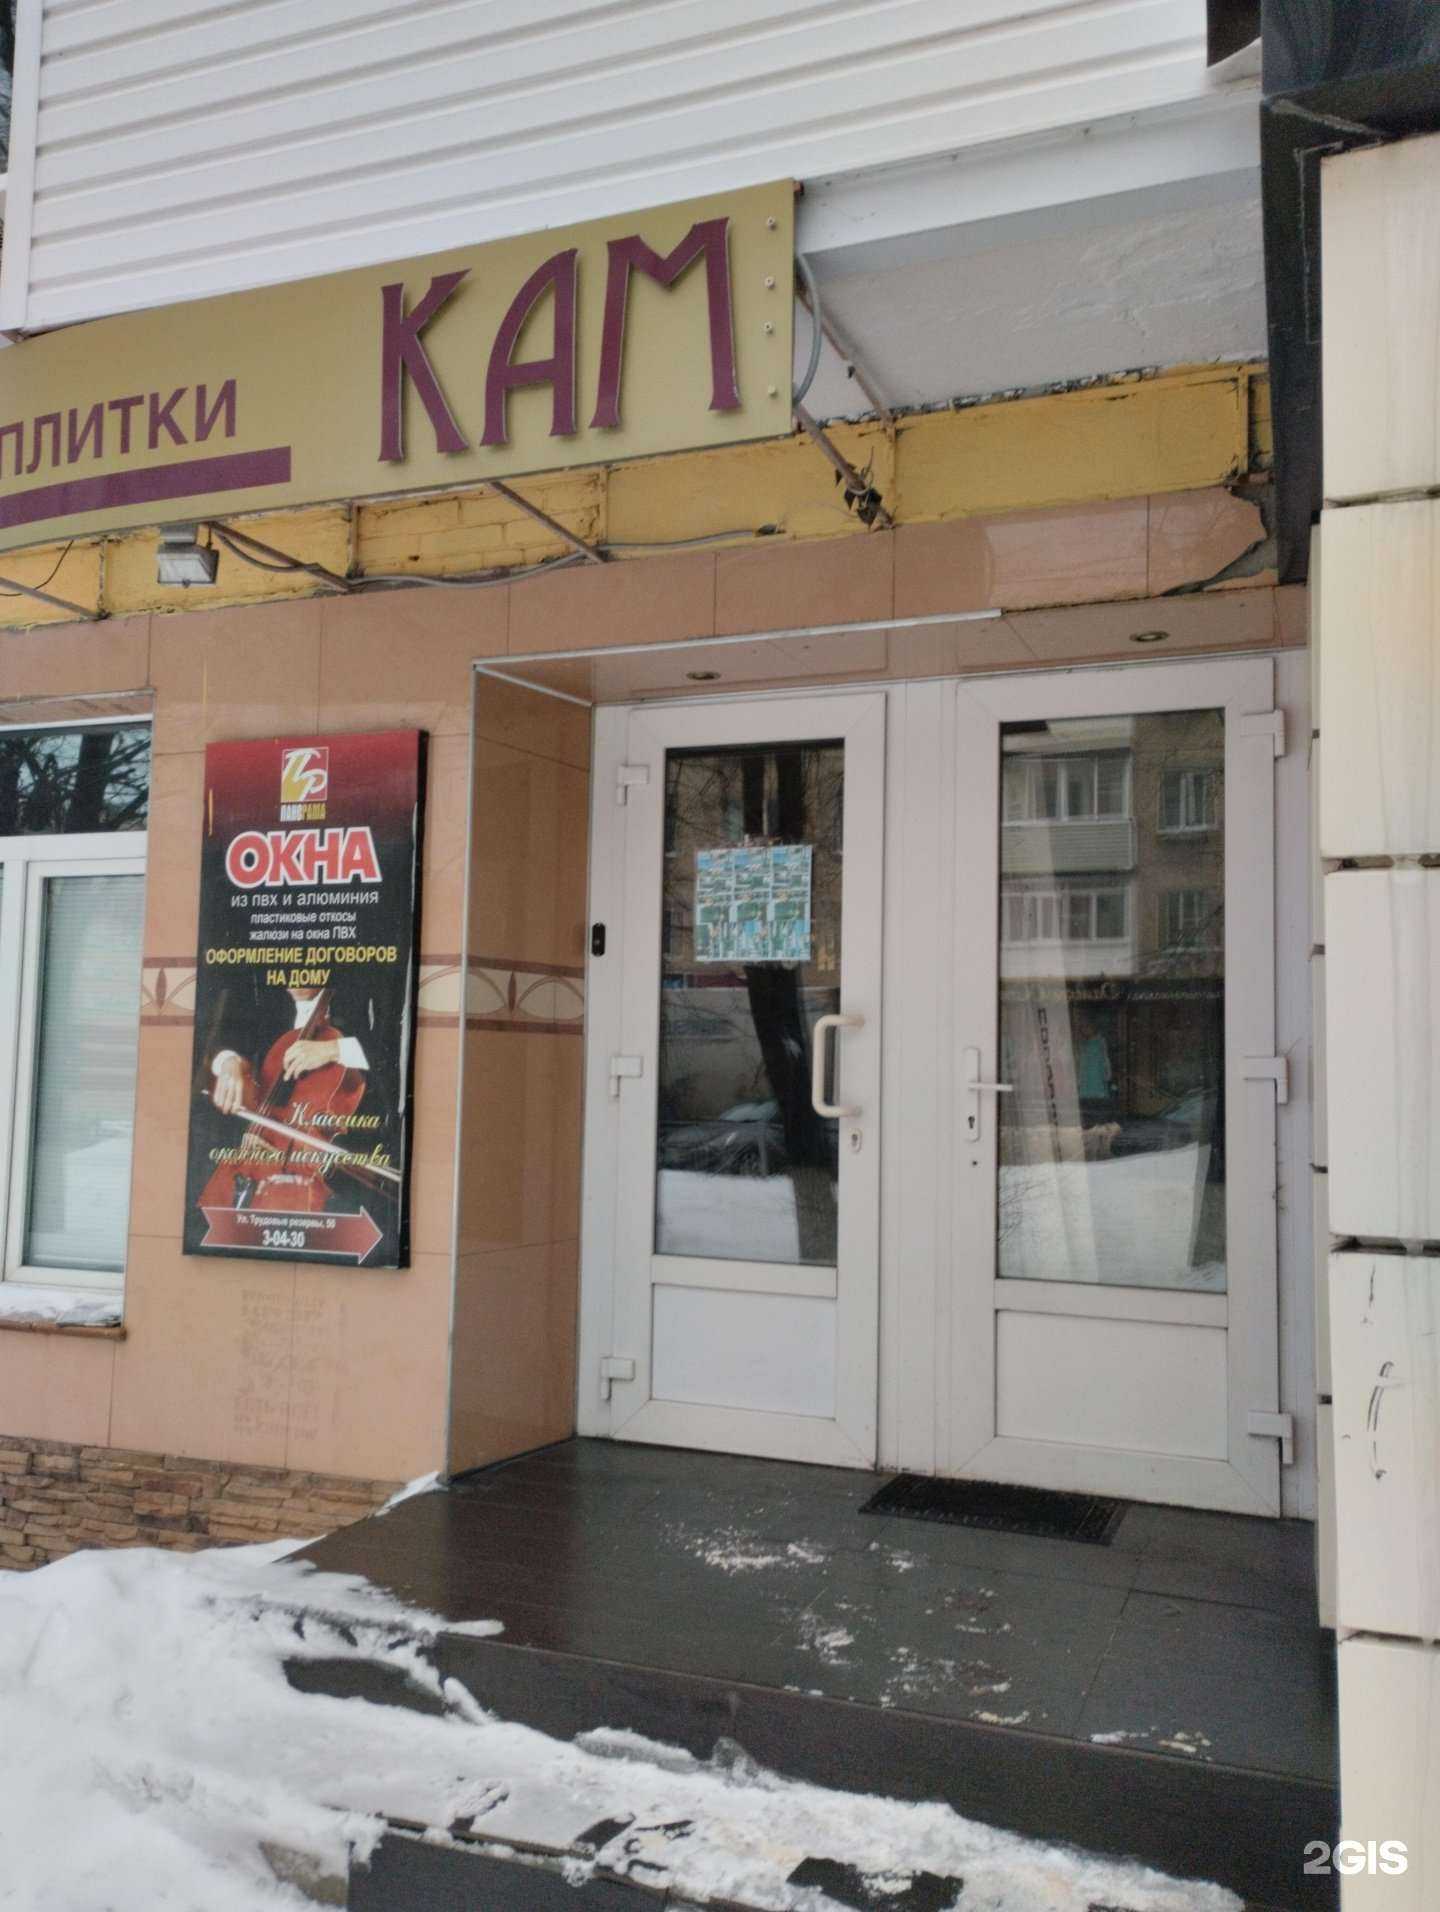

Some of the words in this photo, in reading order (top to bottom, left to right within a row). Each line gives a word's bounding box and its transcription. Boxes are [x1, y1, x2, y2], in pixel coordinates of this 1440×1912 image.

[378, 216, 741, 464] КАМ
[225, 826, 383, 889] ОКНА
[250, 912, 317, 924] пластиковые
[318, 910, 357, 923] откосы
[249, 928, 289, 941] жалюзи
[291, 928, 304, 940] на
[305, 927, 330, 940] окна
[332, 925, 357, 939] ПВХ
[205, 947, 303, 965] ОФОРМЛЕНИЕ
[304, 945, 398, 965] ДОГОВОРОВ
[266, 968, 287, 986] НА
[288, 968, 331, 987] ДОМУ
[286, 1101, 381, 1129] Классика
[208, 1146, 286, 1166] оконного
[262, 1229, 306, 1248] 3-04-30
